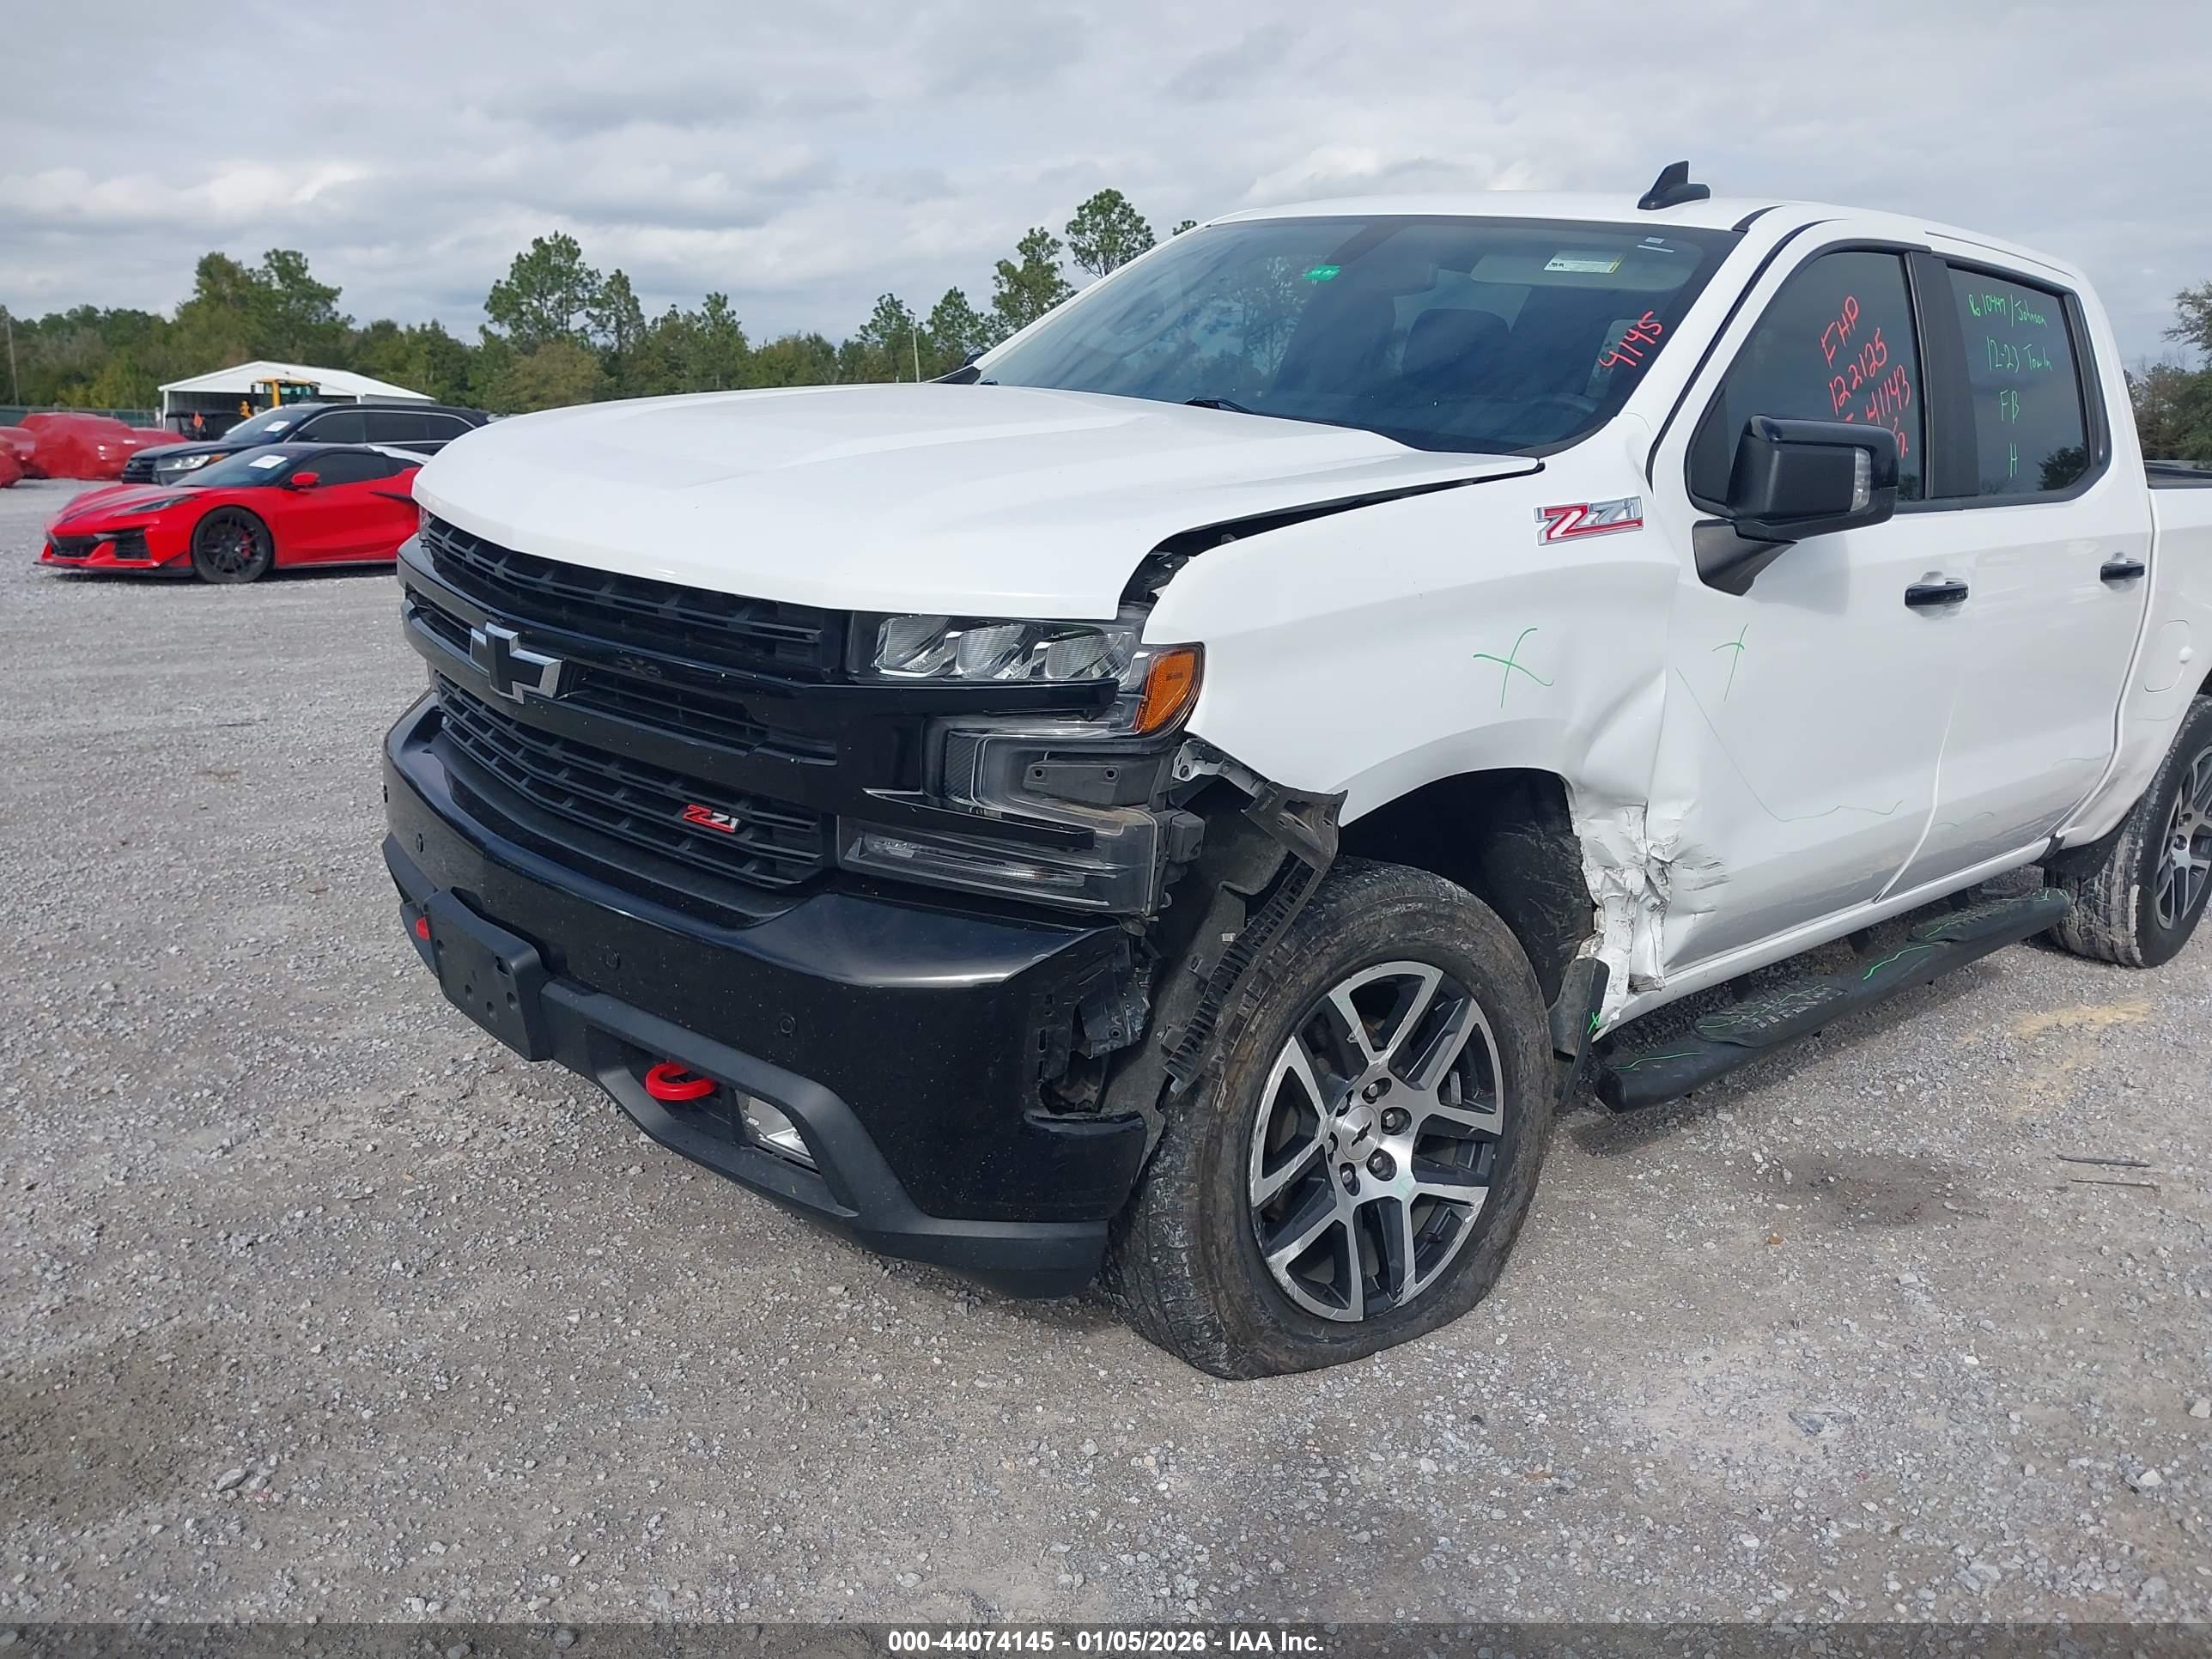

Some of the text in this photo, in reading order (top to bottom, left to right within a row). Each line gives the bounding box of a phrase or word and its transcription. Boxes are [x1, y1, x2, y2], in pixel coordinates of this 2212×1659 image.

[1599, 310, 1662, 367] 4145
[1820, 295, 1860, 369] FHP
[1999, 389, 2020, 425] FB
[2009, 441, 2019, 478] H
[1534, 495, 1644, 546] Z71
[683, 804, 740, 833] Z71
